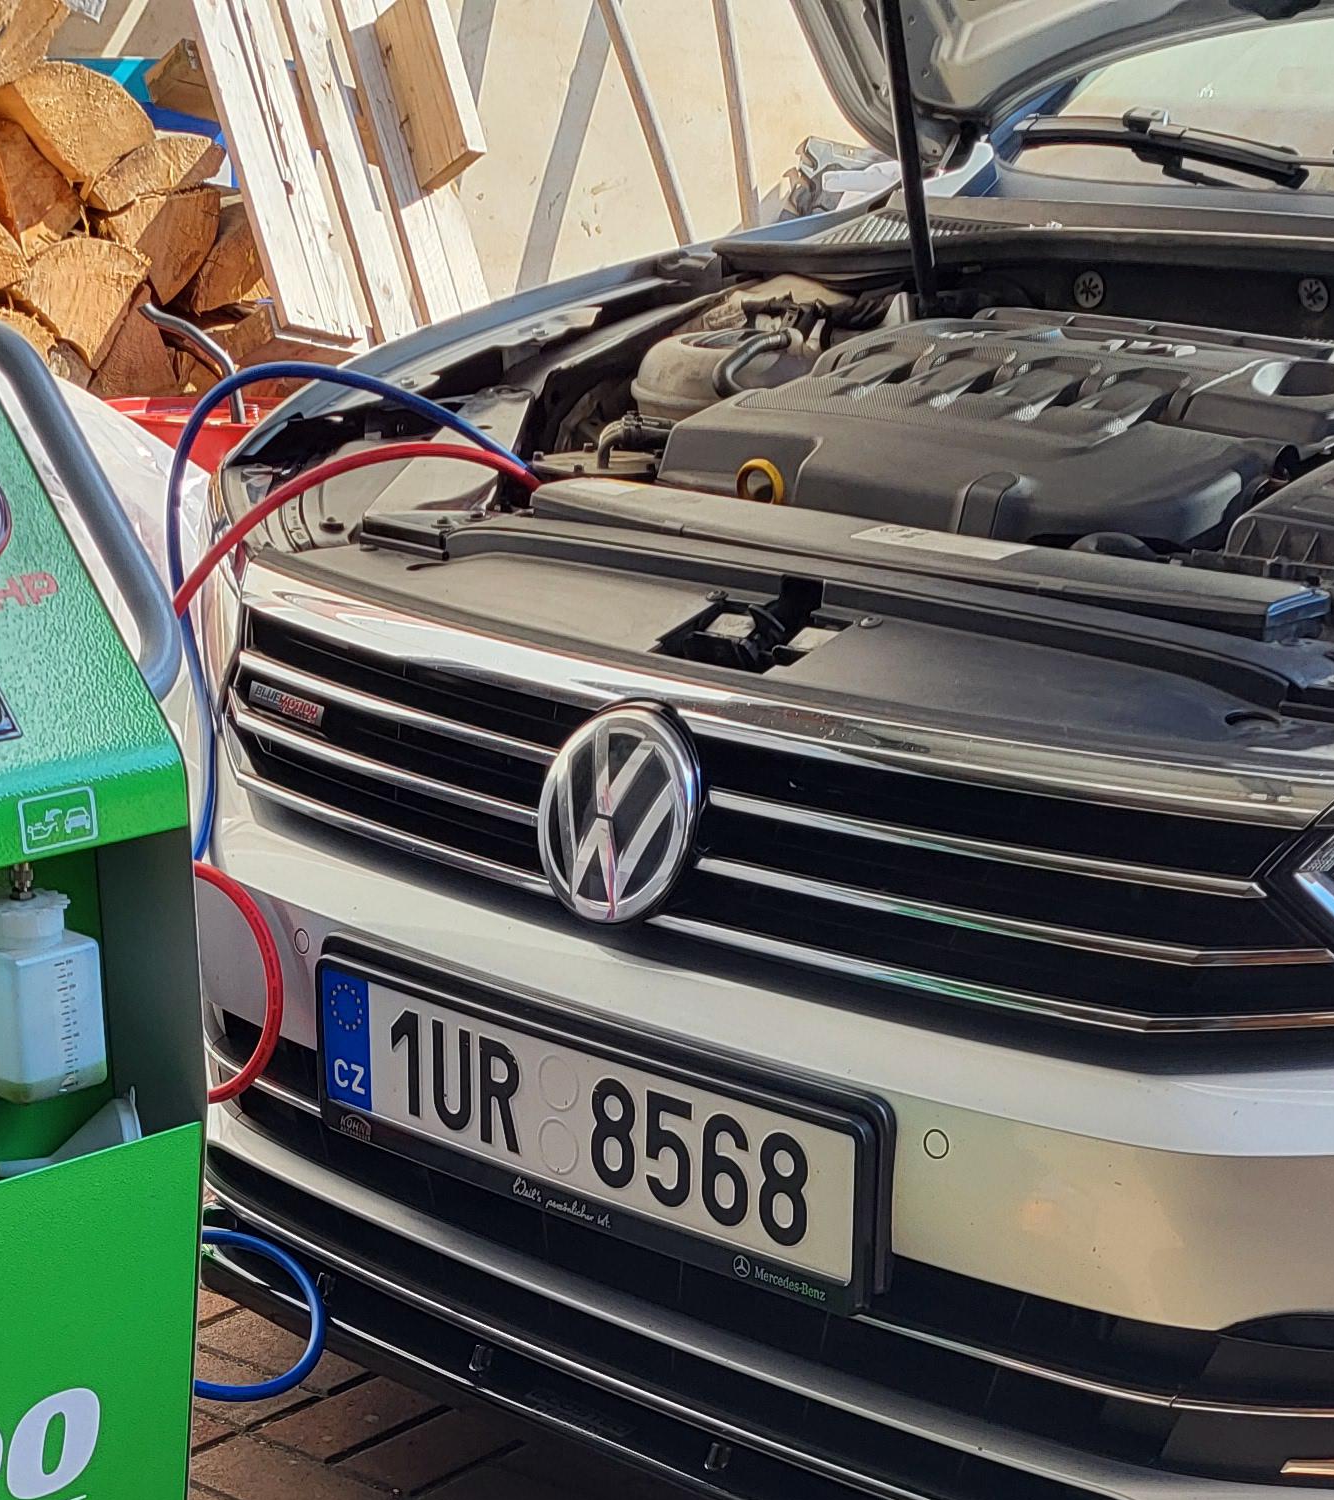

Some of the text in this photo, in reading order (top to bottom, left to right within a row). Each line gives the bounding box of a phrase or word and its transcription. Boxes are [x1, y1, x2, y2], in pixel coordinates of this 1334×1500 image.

[333, 1058, 366, 1096] CZ
[390, 1008, 809, 1248] 1UR 8568
[753, 1265, 827, 1301] Mercedes-Benz
